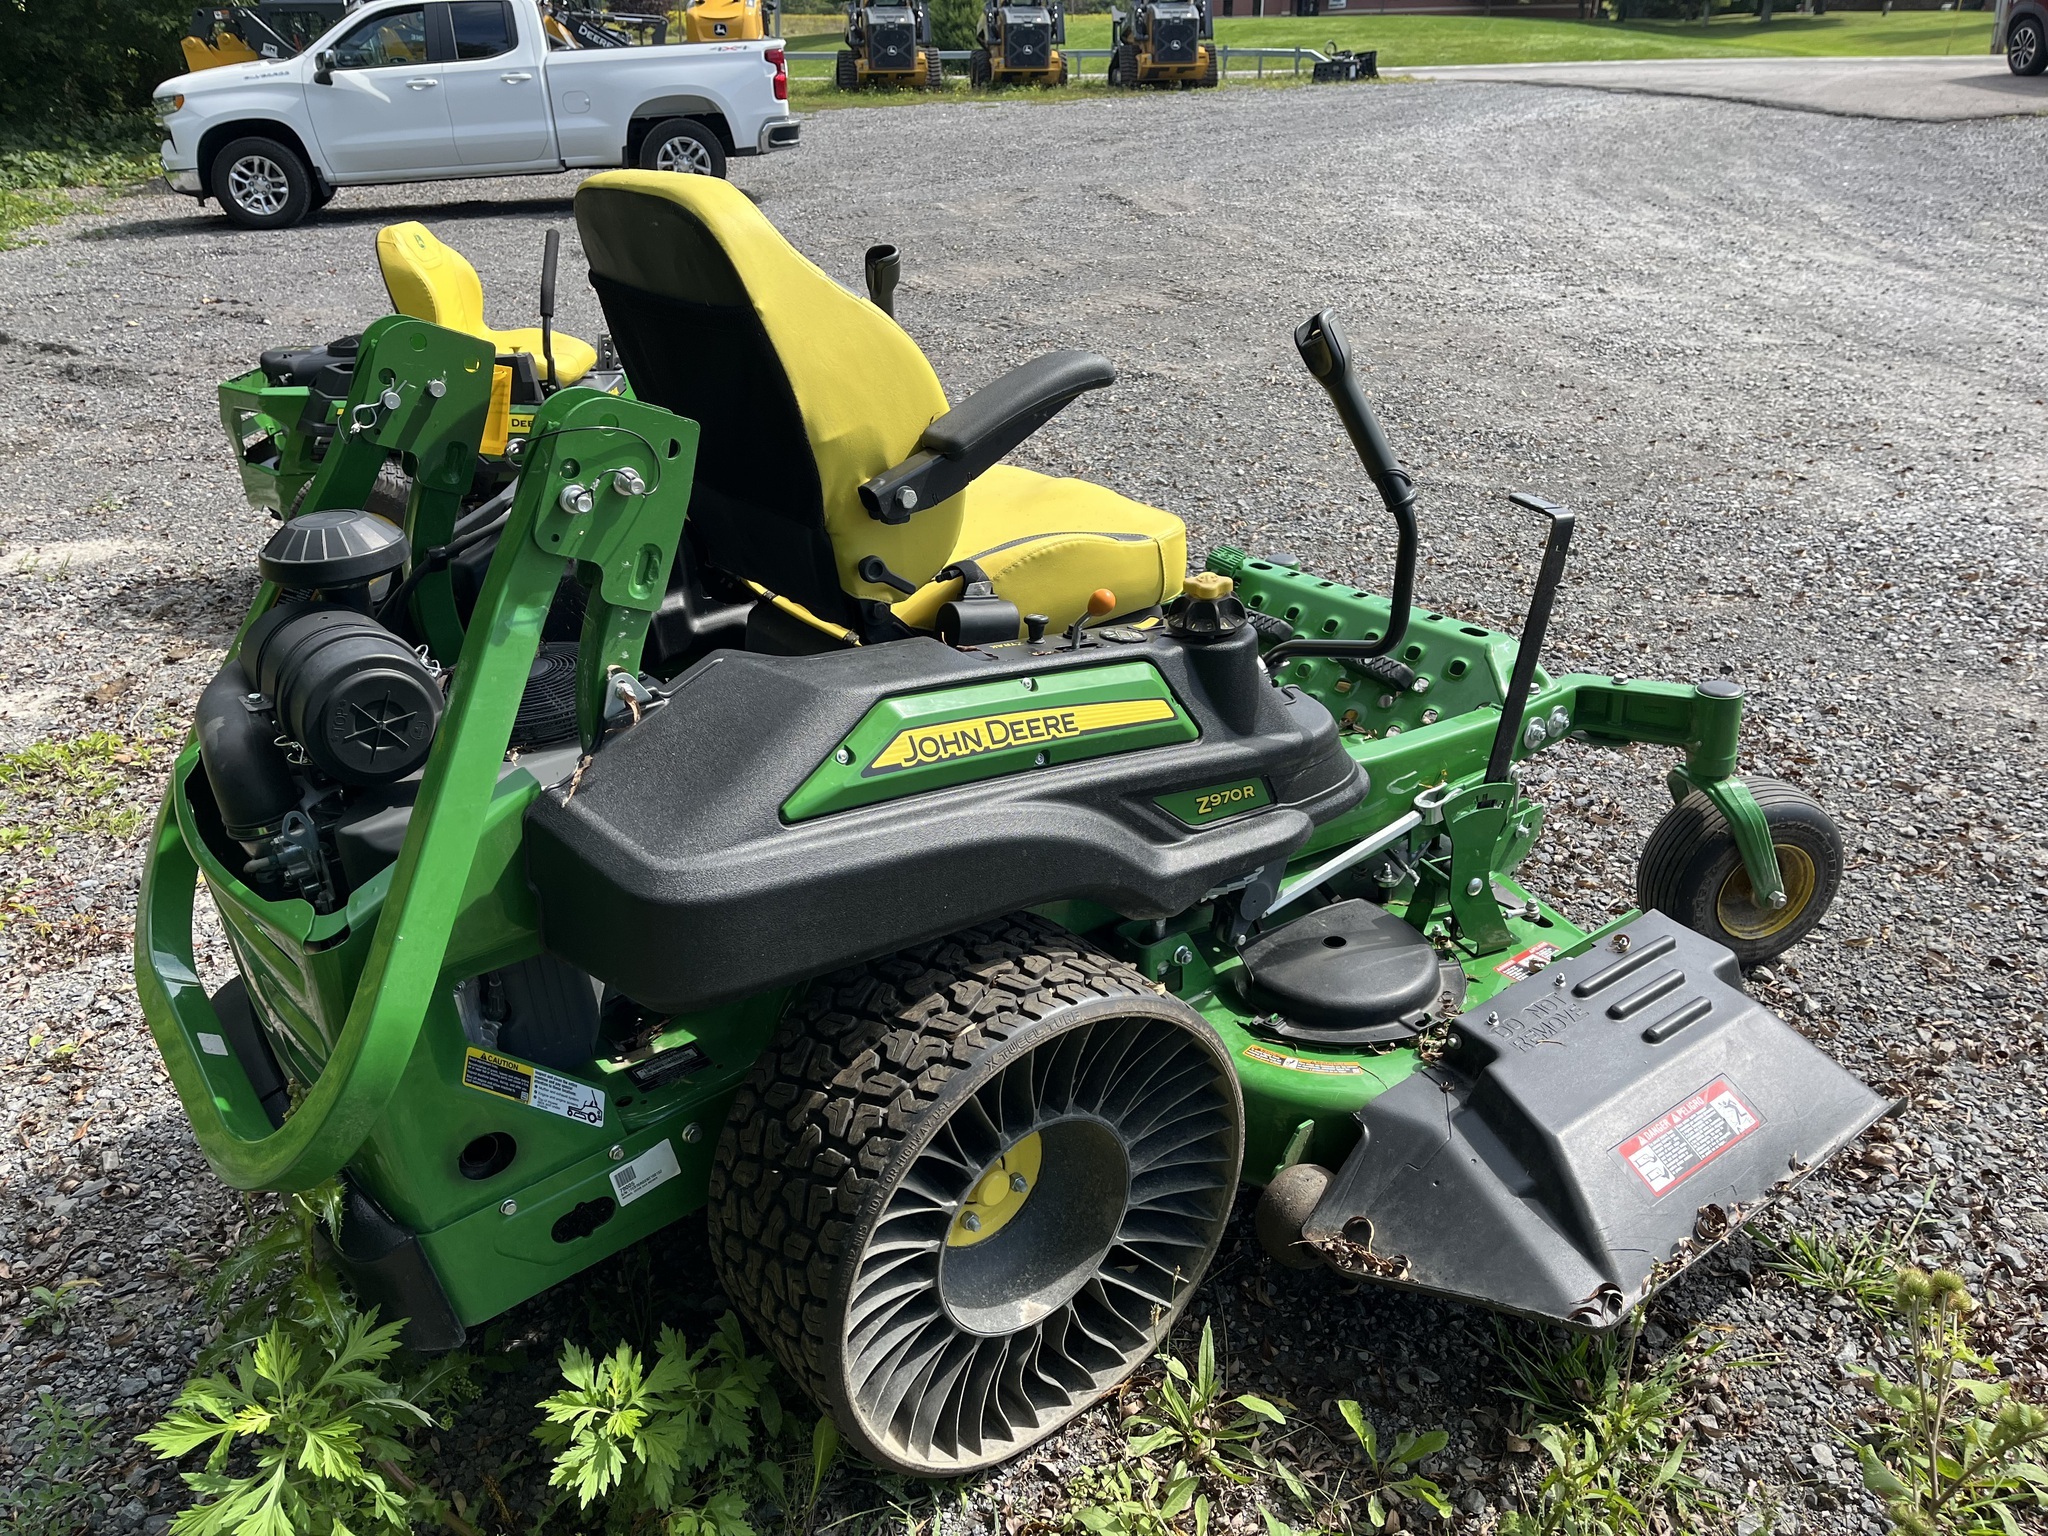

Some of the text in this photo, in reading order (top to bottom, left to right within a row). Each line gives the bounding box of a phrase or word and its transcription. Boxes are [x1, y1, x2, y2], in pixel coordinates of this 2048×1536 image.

[901, 712, 1077, 768] JOHN DEERE
[1195, 783, 1256, 816] Z970R
[997, 1028, 1045, 1060] TWEEL
[1045, 1010, 1082, 1032] TURF
[1491, 992, 1567, 1038] DO NOT
[1511, 1004, 1590, 1052] REMOVE
[488, 1055, 519, 1071] CAUTION
[1643, 1118, 1672, 1141] DANGER
[1677, 1096, 1705, 1118] PELIGRO
[867, 1192, 883, 1215] NOT
[883, 1168, 899, 1191] FOR
[896, 1123, 932, 1169] HIGHWAY
